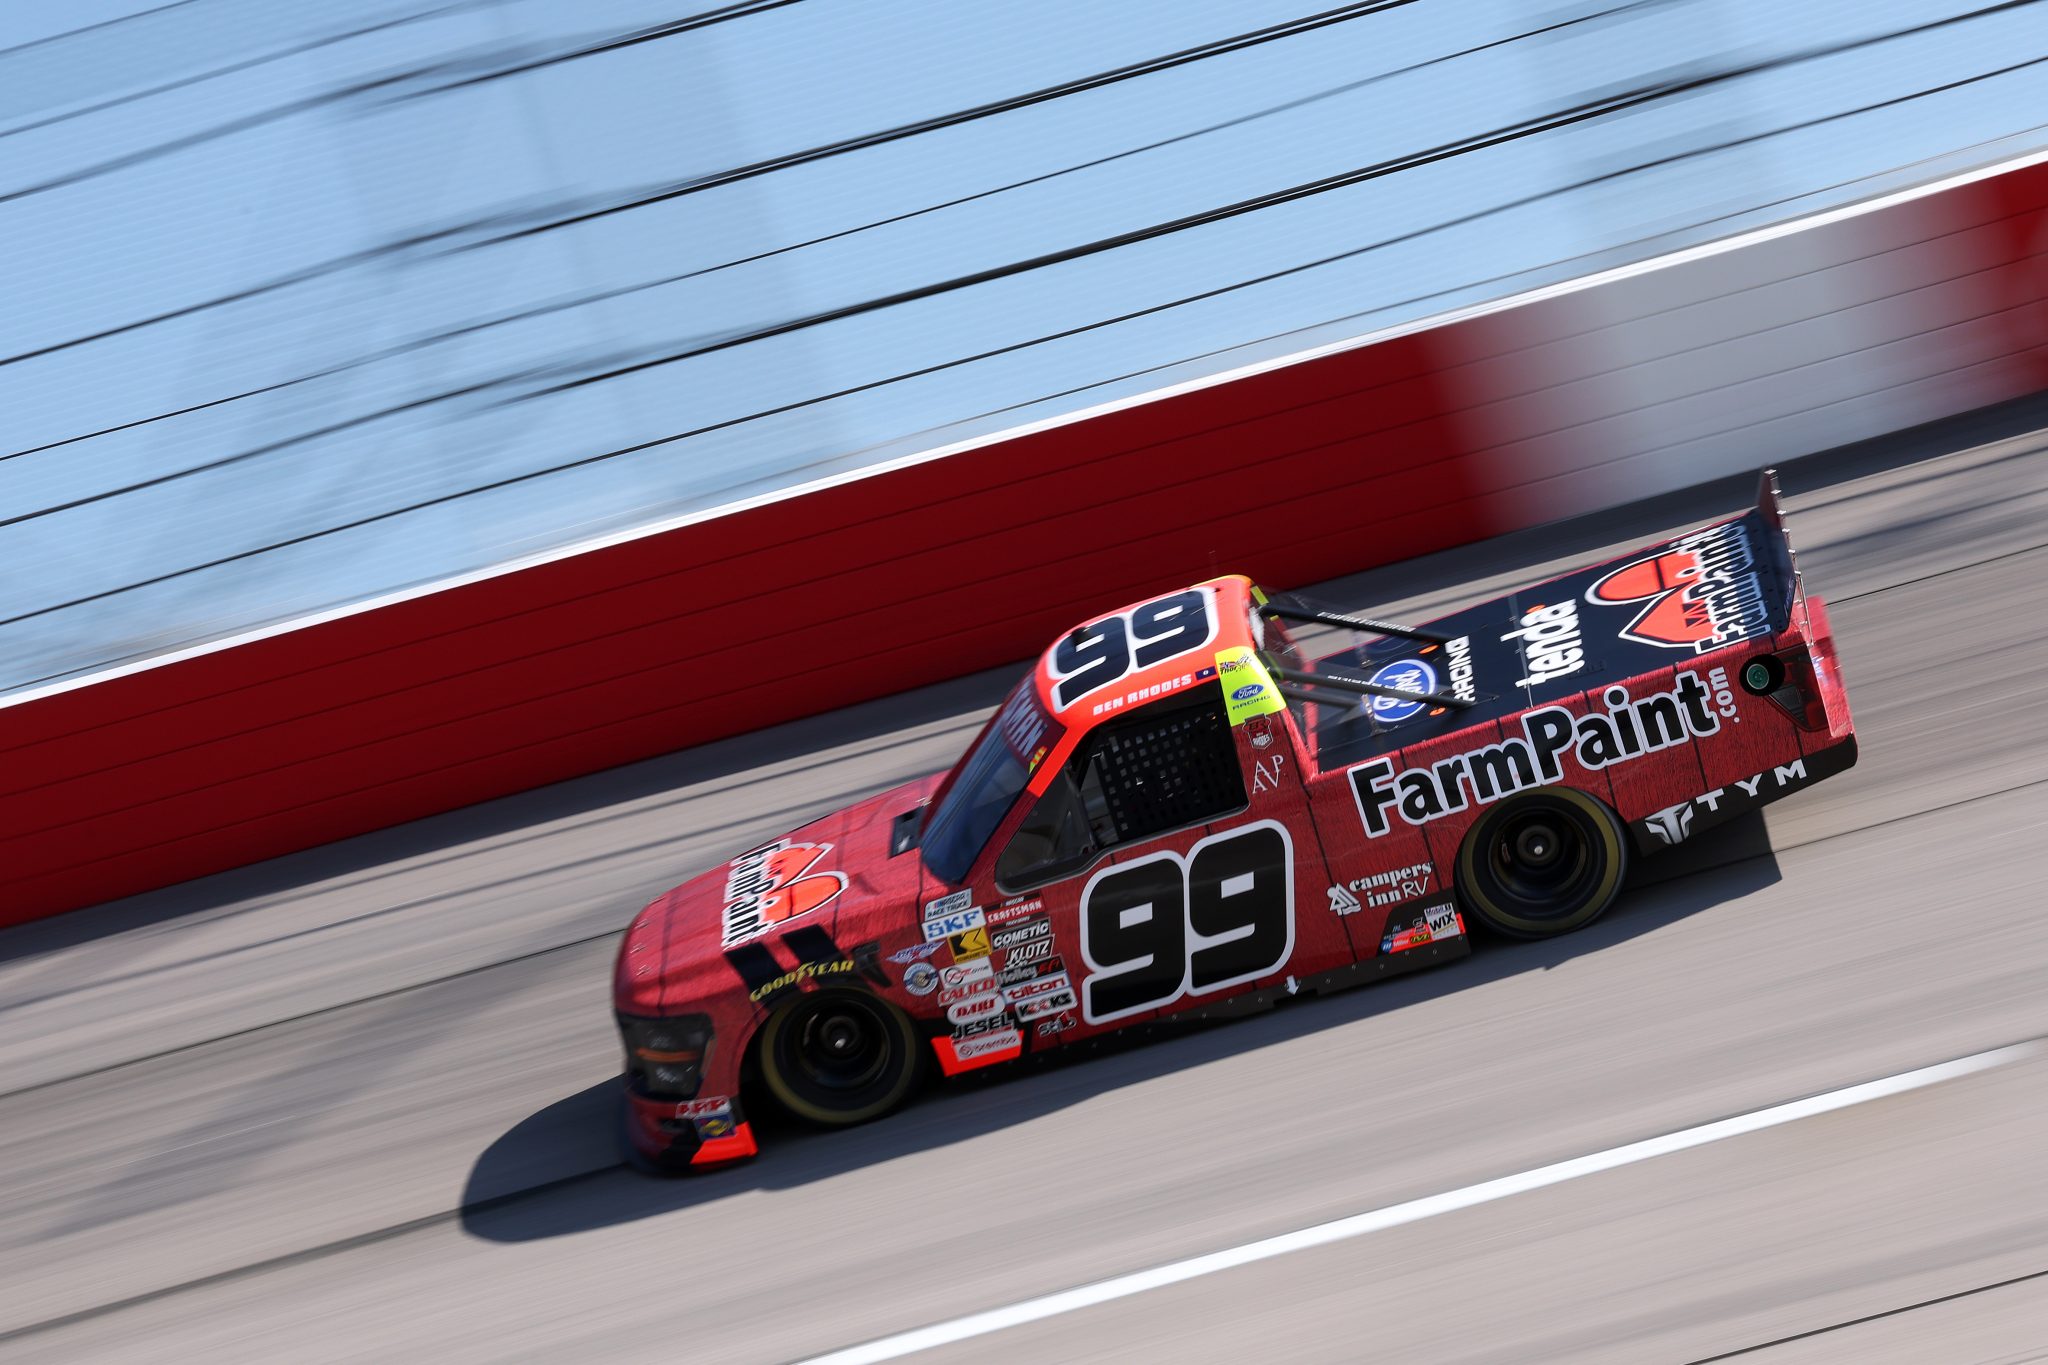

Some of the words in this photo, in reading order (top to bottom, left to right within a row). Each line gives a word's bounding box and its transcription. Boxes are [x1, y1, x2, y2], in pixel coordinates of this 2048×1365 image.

[1675, 524, 1771, 654] FarmPaint
[1046, 586, 1219, 714] 99
[1500, 599, 1585, 690] tenda
[1445, 635, 1476, 702] RACING
[1093, 697, 1124, 717] BEN
[1127, 674, 1193, 704] RHODES
[1232, 694, 1271, 711] RACING
[1708, 666, 1740, 723] .com
[1347, 669, 1721, 839] FarmPaint
[1695, 758, 1808, 812] TYM
[1349, 862, 1433, 893] campers
[1366, 889, 1402, 908] inn
[1401, 876, 1430, 899] RV
[927, 910, 980, 939] SKF
[988, 901, 1042, 924] CRAFTSMAN
[1079, 818, 1296, 1026] 99
[1429, 912, 1456, 932] WIX
[993, 922, 1049, 946] COMETIC
[1008, 940, 1051, 963] KLOTZ
[750, 960, 855, 1003] GOODYEAR
[940, 976, 996, 1003] CALICO
[1007, 977, 1066, 1000] tilton
[953, 1013, 1015, 1039] JESEL
